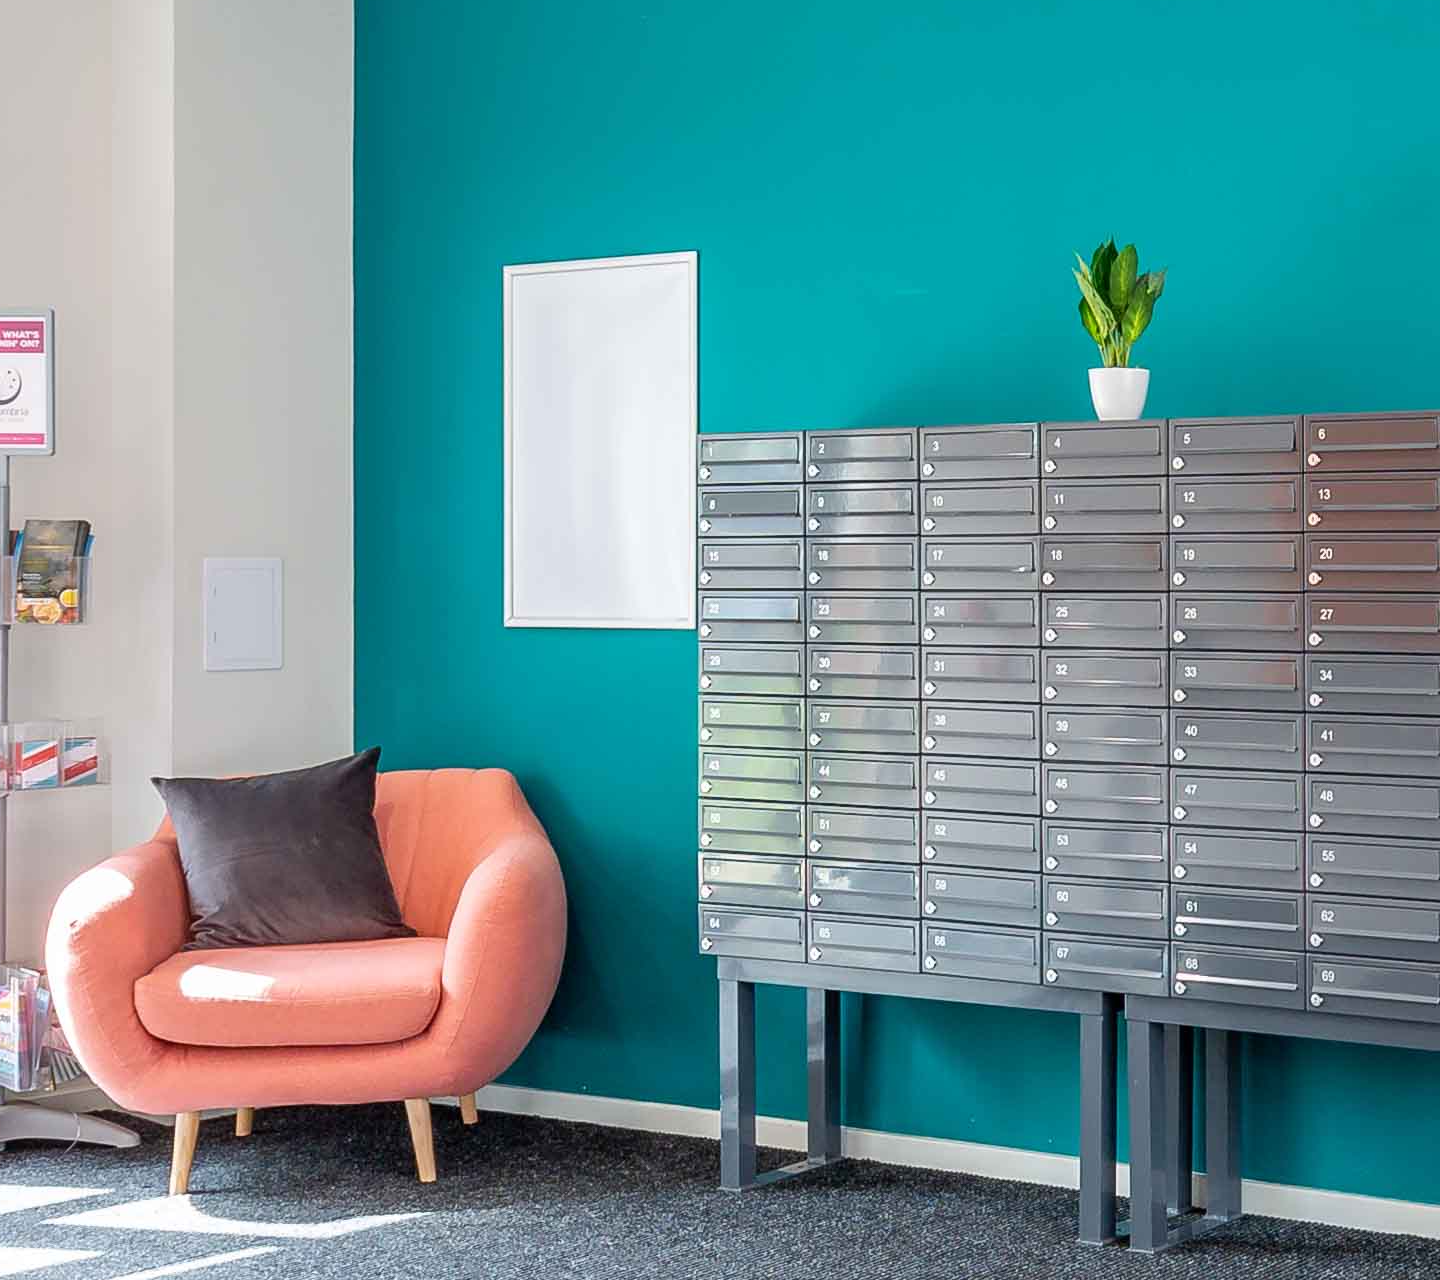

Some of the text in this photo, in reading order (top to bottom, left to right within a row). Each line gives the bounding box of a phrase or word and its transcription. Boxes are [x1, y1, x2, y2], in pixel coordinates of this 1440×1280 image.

[1183, 433, 1191, 445] 5
[1318, 428, 1326, 440] 6
[818, 443, 825, 454] 2
[932, 440, 940, 452] 3
[1054, 437, 1061, 448] 4
[1054, 493, 1064, 505] 11
[1183, 491, 1195, 503] 12
[1318, 488, 1331, 500] 13
[817, 496, 825, 508] 9
[932, 495, 944, 507] 10
[709, 551, 719, 561] 15
[932, 549, 944, 561] 17
[1050, 549, 1063, 561] 18
[1183, 549, 1195, 561] 19
[1319, 547, 1333, 560] 20
[818, 604, 830, 615] 23
[933, 605, 945, 617] 24
[1055, 606, 1069, 618] 25
[1184, 607, 1197, 619] 26
[1319, 608, 1334, 620] 27
[818, 657, 831, 668] 30
[934, 660, 945, 672] 31
[1055, 663, 1068, 676] 32
[1184, 666, 1197, 678] 33
[1319, 669, 1333, 681] 34
[819, 712, 831, 723] 37
[1055, 720, 1069, 732] 39
[1184, 725, 1198, 737] 40
[1320, 729, 1333, 742] 41
[818, 765, 830, 777] 44
[933, 769, 946, 781] 45
[1055, 778, 1068, 789] 46
[1184, 784, 1198, 795] 47
[1319, 790, 1334, 802] 48
[934, 824, 947, 836] 52
[1056, 834, 1069, 846] 53
[1184, 842, 1197, 854] 54
[1321, 849, 1336, 862] 55
[1056, 890, 1069, 902] 60
[1185, 900, 1198, 913] 61
[1320, 909, 1335, 922] 62
[709, 917, 720, 929] 64
[1056, 947, 1069, 959] 67
[1185, 957, 1199, 970] 68
[1321, 970, 1335, 983] 69
